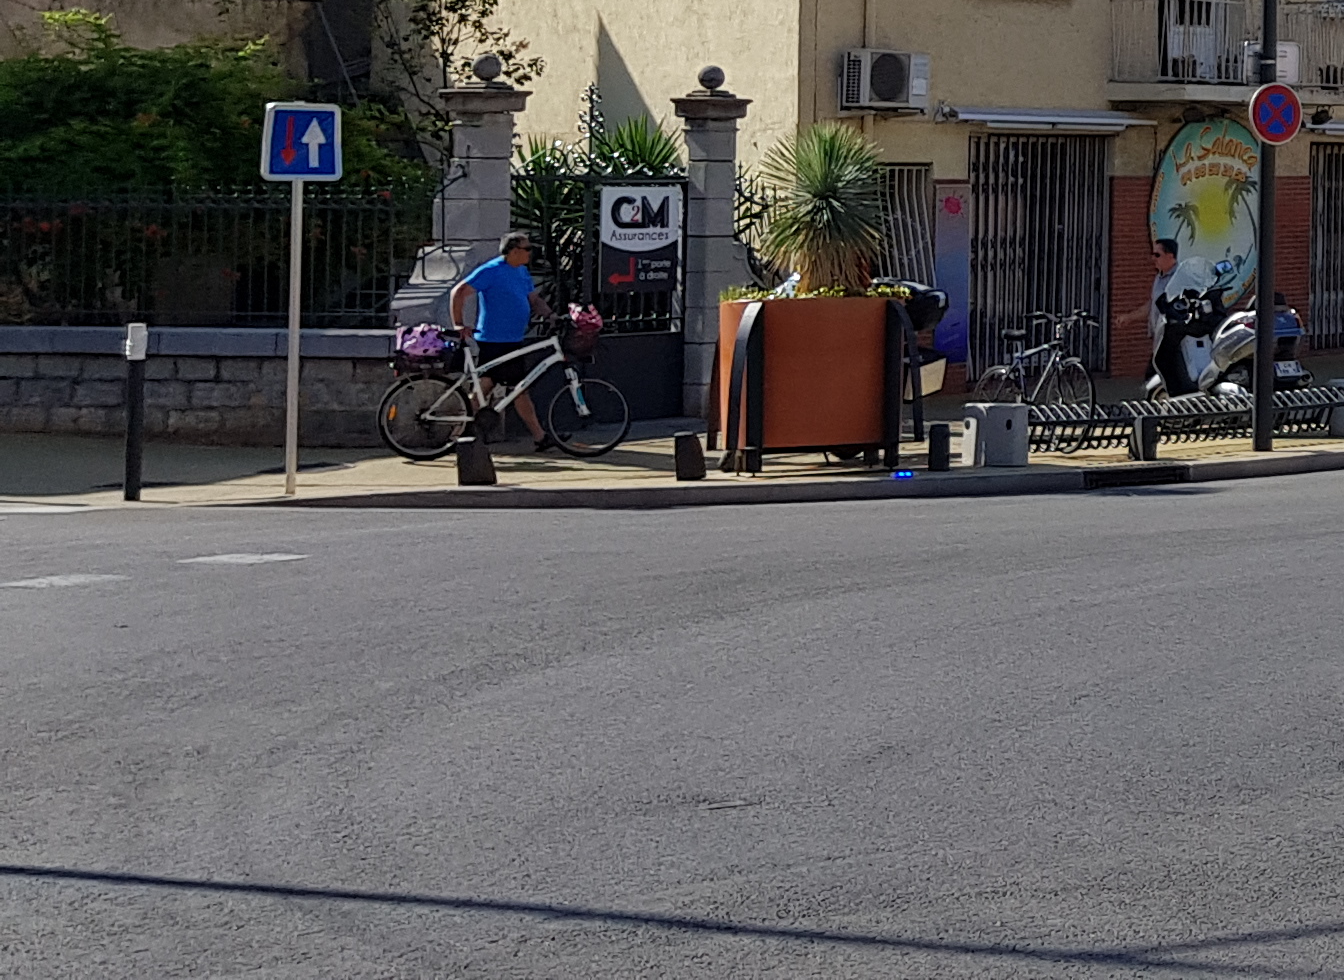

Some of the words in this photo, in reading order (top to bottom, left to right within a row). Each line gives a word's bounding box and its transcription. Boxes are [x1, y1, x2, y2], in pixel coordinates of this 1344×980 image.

[1171, 142, 1195, 174] La
[611, 195, 670, 229] C2M
[610, 230, 669, 241] Assurances
